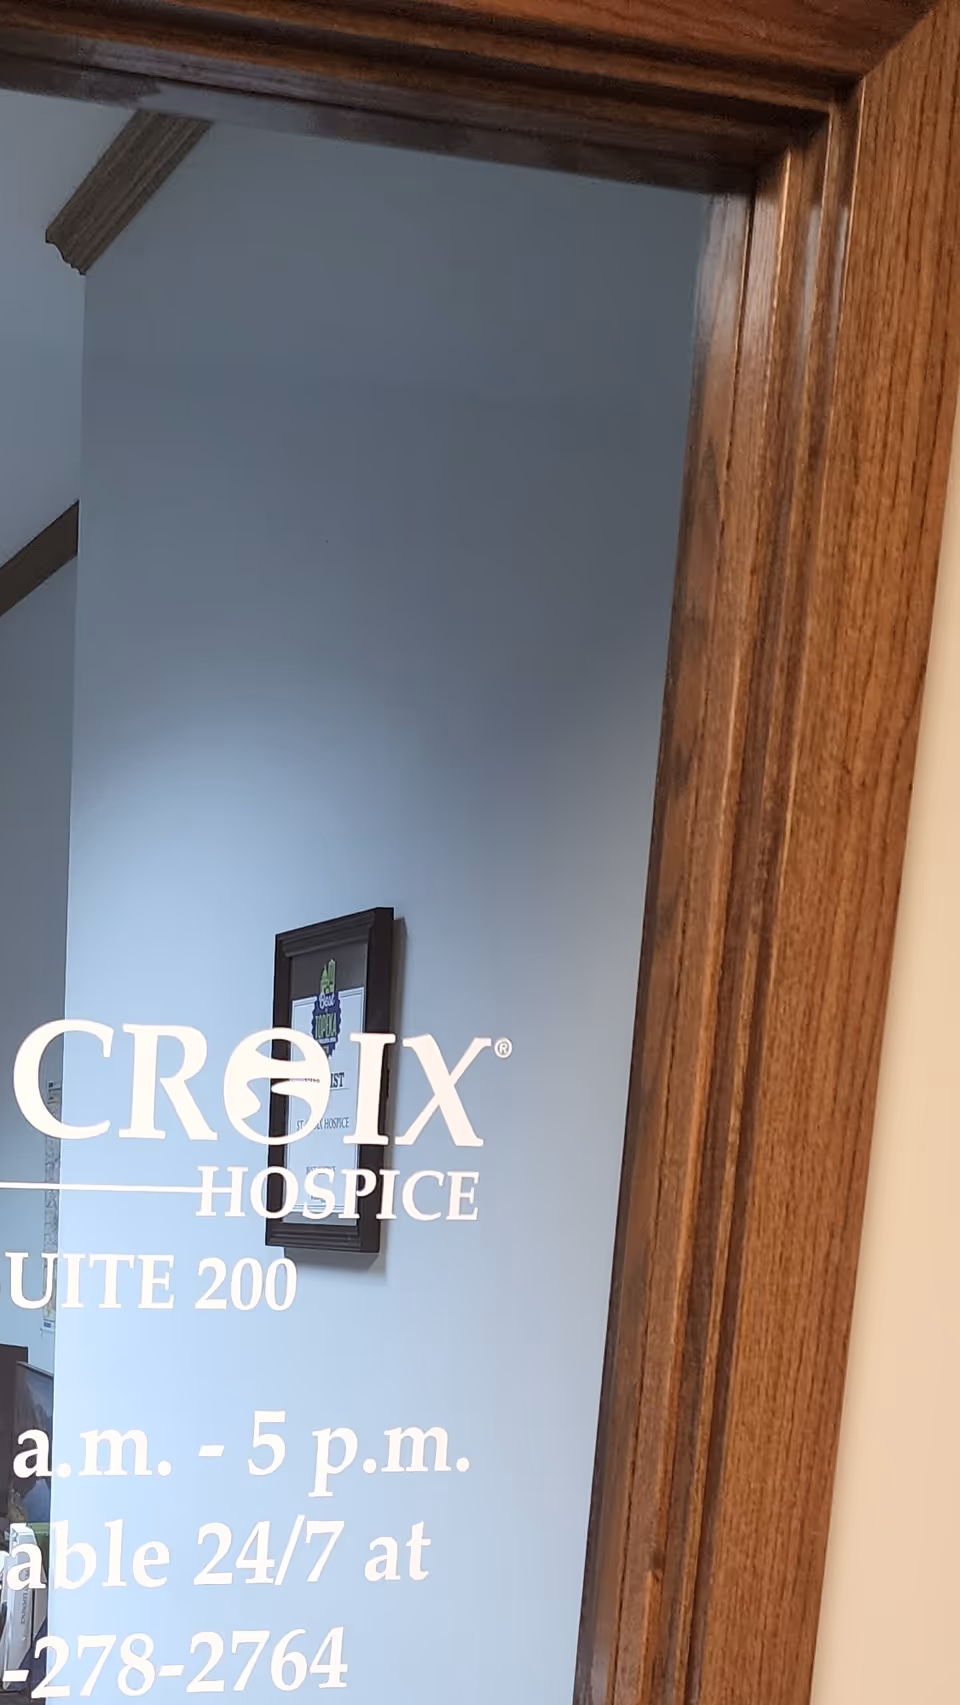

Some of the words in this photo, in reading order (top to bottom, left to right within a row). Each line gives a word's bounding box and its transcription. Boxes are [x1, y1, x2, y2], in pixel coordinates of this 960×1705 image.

[195, 1165, 480, 1222] HOSPICE
[197, 1256, 298, 1312] 200
[12, 1427, 173, 1480] a.m.
[247, 1410, 287, 1476] 5
[308, 1424, 471, 1498] p.m.
[193, 1514, 347, 1587] 24/7
[364, 1519, 431, 1582] at
